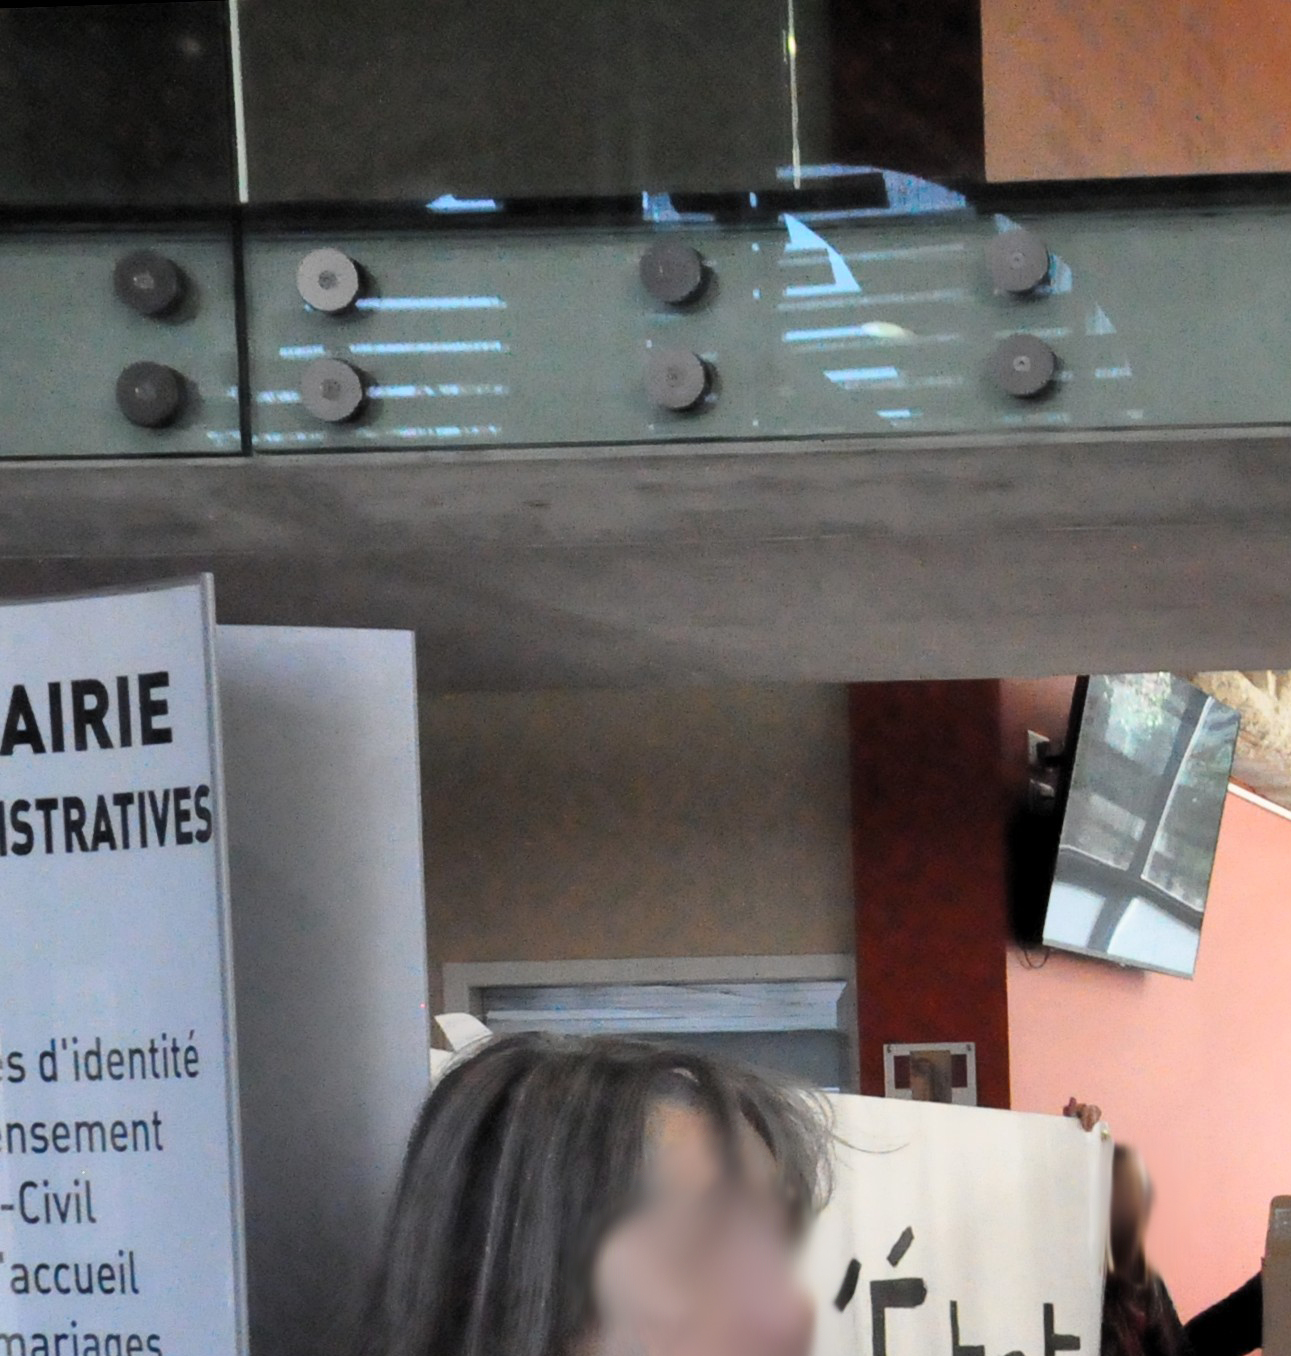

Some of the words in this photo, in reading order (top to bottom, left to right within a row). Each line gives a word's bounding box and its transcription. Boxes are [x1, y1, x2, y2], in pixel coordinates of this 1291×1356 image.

[0, 670, 173, 756] AIRIE
[0, 1050, 26, 1083] s
[39, 1029, 199, 1083] d'identité
[0, 1111, 164, 1154] nsement
